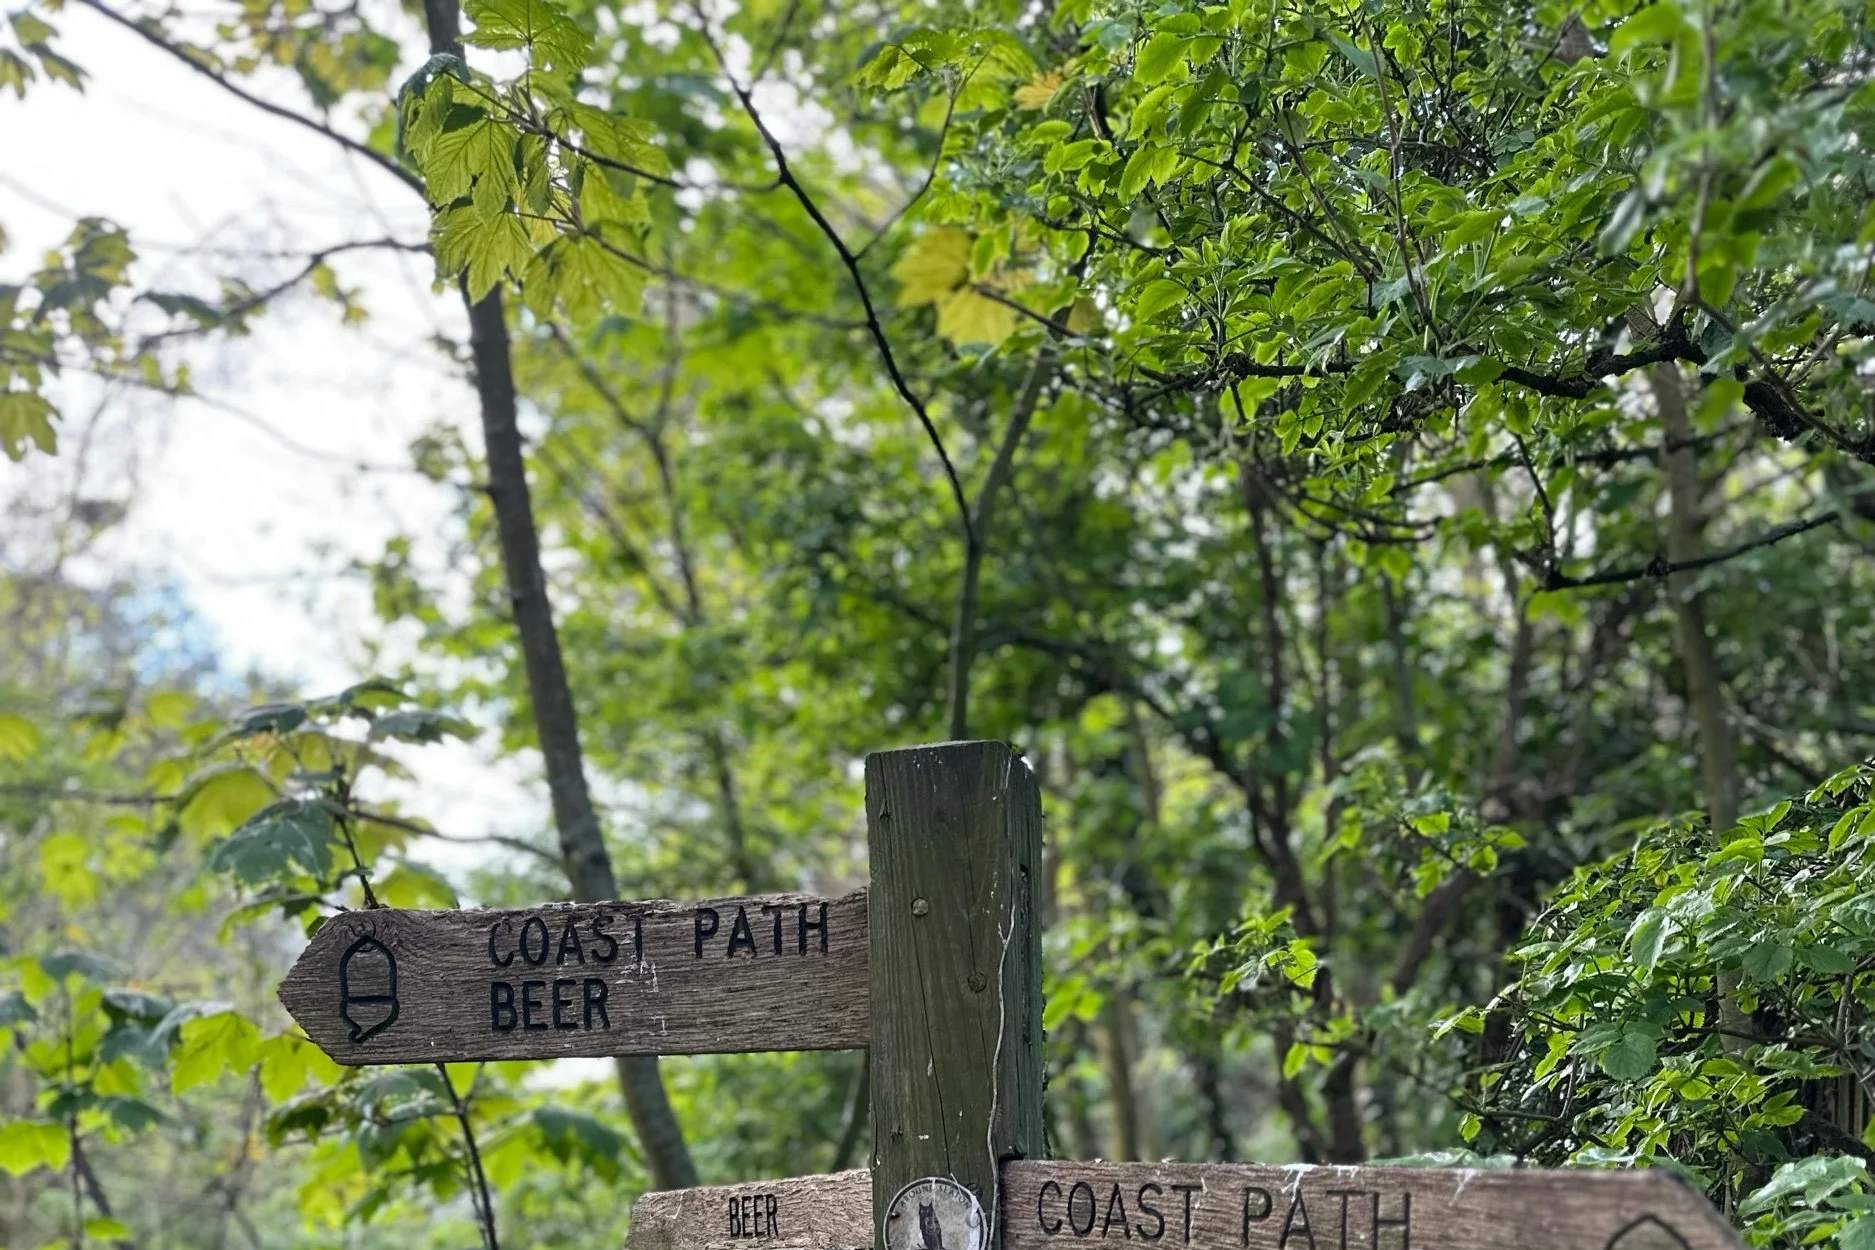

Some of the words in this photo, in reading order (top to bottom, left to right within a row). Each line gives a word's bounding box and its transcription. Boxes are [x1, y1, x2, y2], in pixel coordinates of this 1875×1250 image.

[488, 914, 645, 969] COAST
[693, 902, 829, 960] PATH
[490, 978, 611, 1033] BEER
[728, 1193, 779, 1239] BEER
[938, 1184, 972, 1209] SEATON
[1037, 1180, 1203, 1245] COAST
